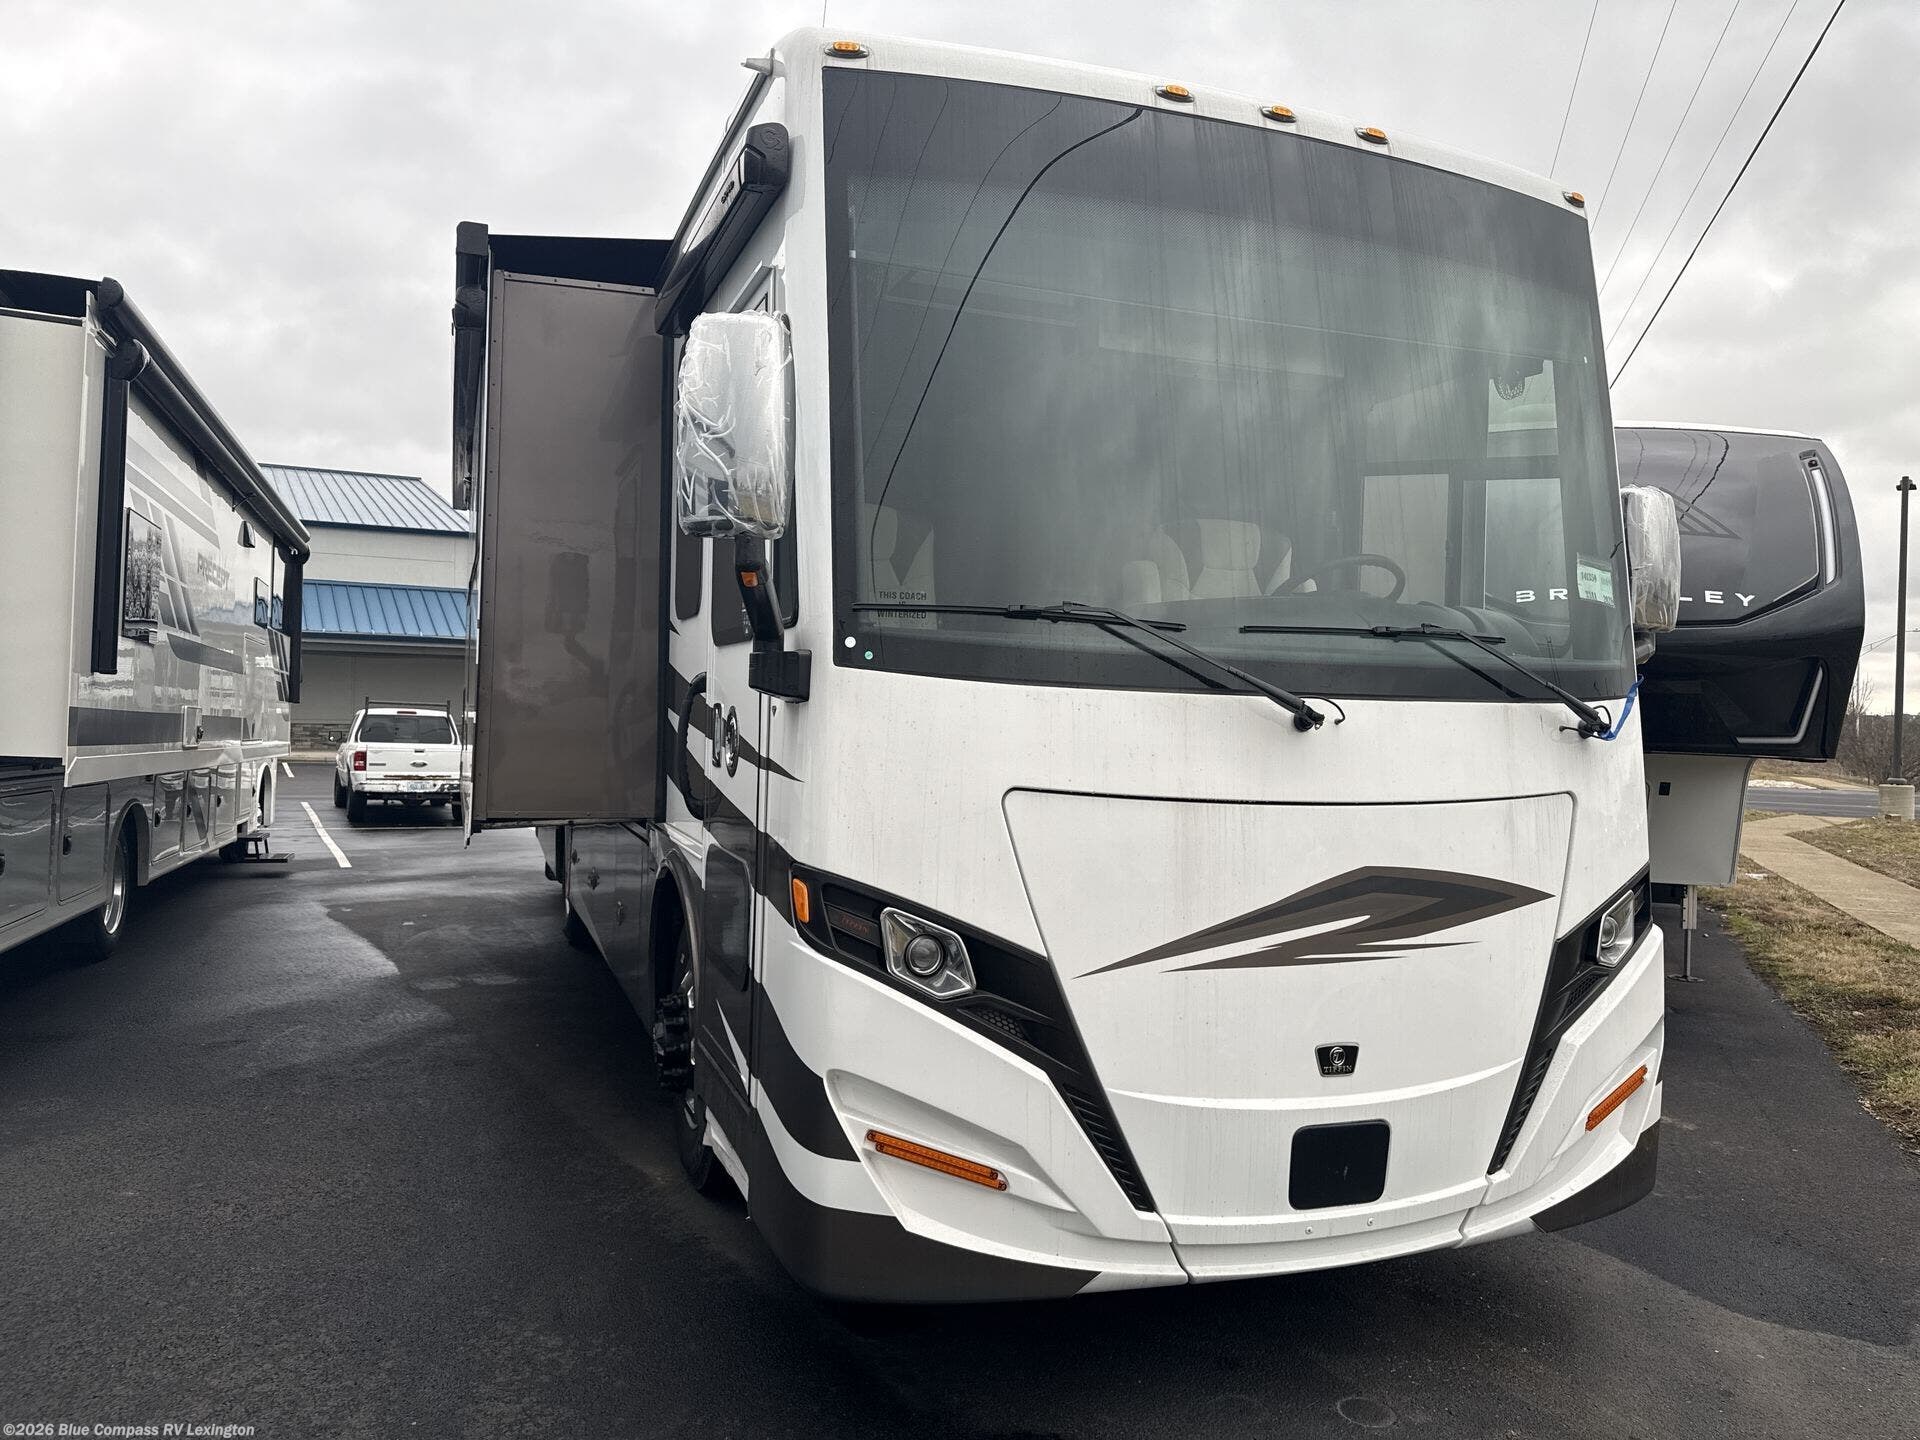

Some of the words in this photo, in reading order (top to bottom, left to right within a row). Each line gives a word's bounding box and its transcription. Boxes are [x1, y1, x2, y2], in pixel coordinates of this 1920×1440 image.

[879, 590, 897, 600] THIS
[899, 591, 927, 601] COACH
[876, 609, 927, 619] WINTERIZED
[1323, 1065, 1352, 1073] TIFFIN
